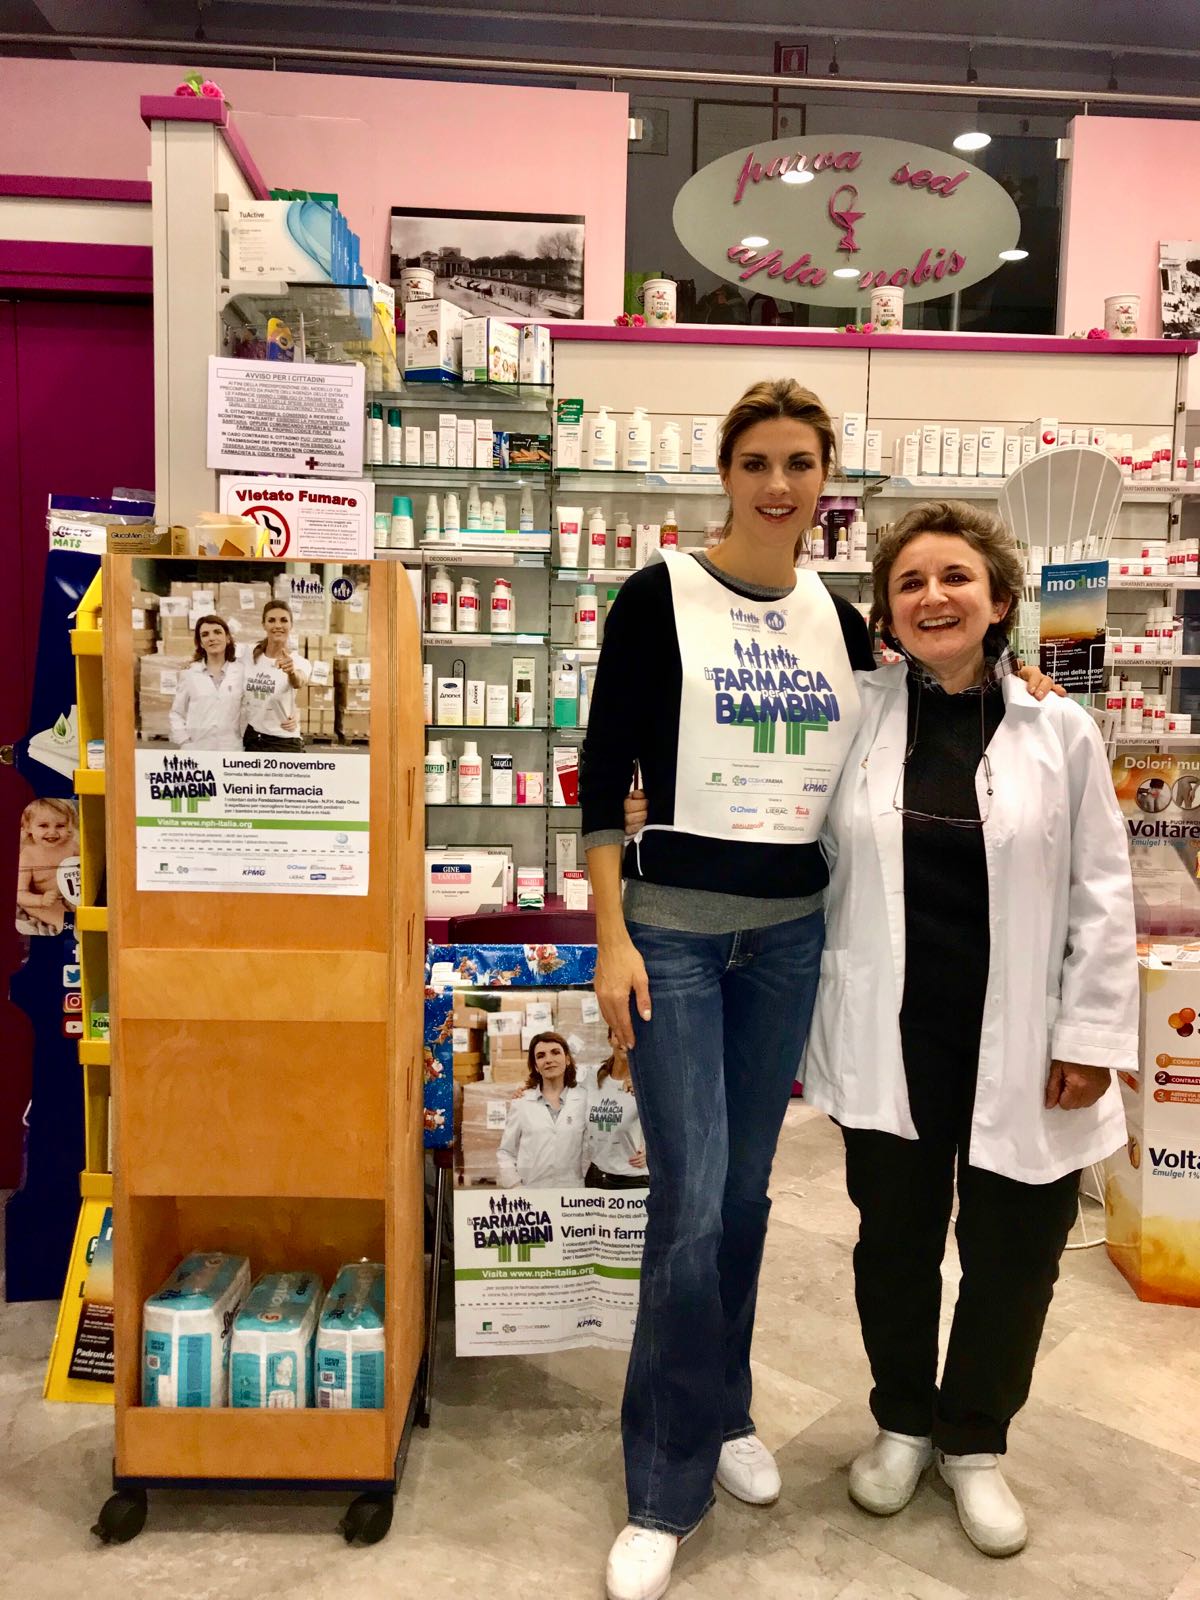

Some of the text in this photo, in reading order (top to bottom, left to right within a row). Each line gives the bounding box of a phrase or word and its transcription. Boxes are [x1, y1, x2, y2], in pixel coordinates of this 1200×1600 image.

[733, 151, 971, 205] parva sed
[727, 244, 967, 288] apta nobis
[236, 490, 357, 507] Vietato Fumare
[53, 538, 82, 548] MATS
[1046, 575, 1106, 592] modus
[713, 667, 833, 693] FARMACIA
[760, 688, 780, 699] per
[715, 692, 840, 724] BAMBINI
[223, 758, 336, 771] Lunedì 20 novembre
[1124, 757, 1200, 770] Dolori mu
[150, 770, 215, 784] FARMACIA
[151, 783, 216, 799] BAMBINI
[223, 784, 323, 796] Vieni in farmacia
[803, 783, 827, 793] KPMG
[157, 818, 252, 829] Visita www.nph-italia.org
[1128, 820, 1200, 838] Voltare
[1131, 839, 1160, 847] Emulgel
[1159, 1074, 1166, 1082] 2
[1158, 1092, 1165, 1100] 3
[589, 1113, 622, 1123] BAMBINI
[1152, 1169, 1185, 1179] Emulgel
[561, 1196, 605, 1208] Lunedì
[608, 1198, 624, 1209] 20
[473, 1211, 551, 1231] FARMACIA
[474, 1225, 553, 1248] BAMBINI
[561, 1224, 596, 1238] Vieni
[599, 1226, 611, 1238] in
[482, 1266, 594, 1278] Visita www.nph-italia.org
[576, 1319, 602, 1328] KPMG
[76, 1348, 105, 1359] Padroni
